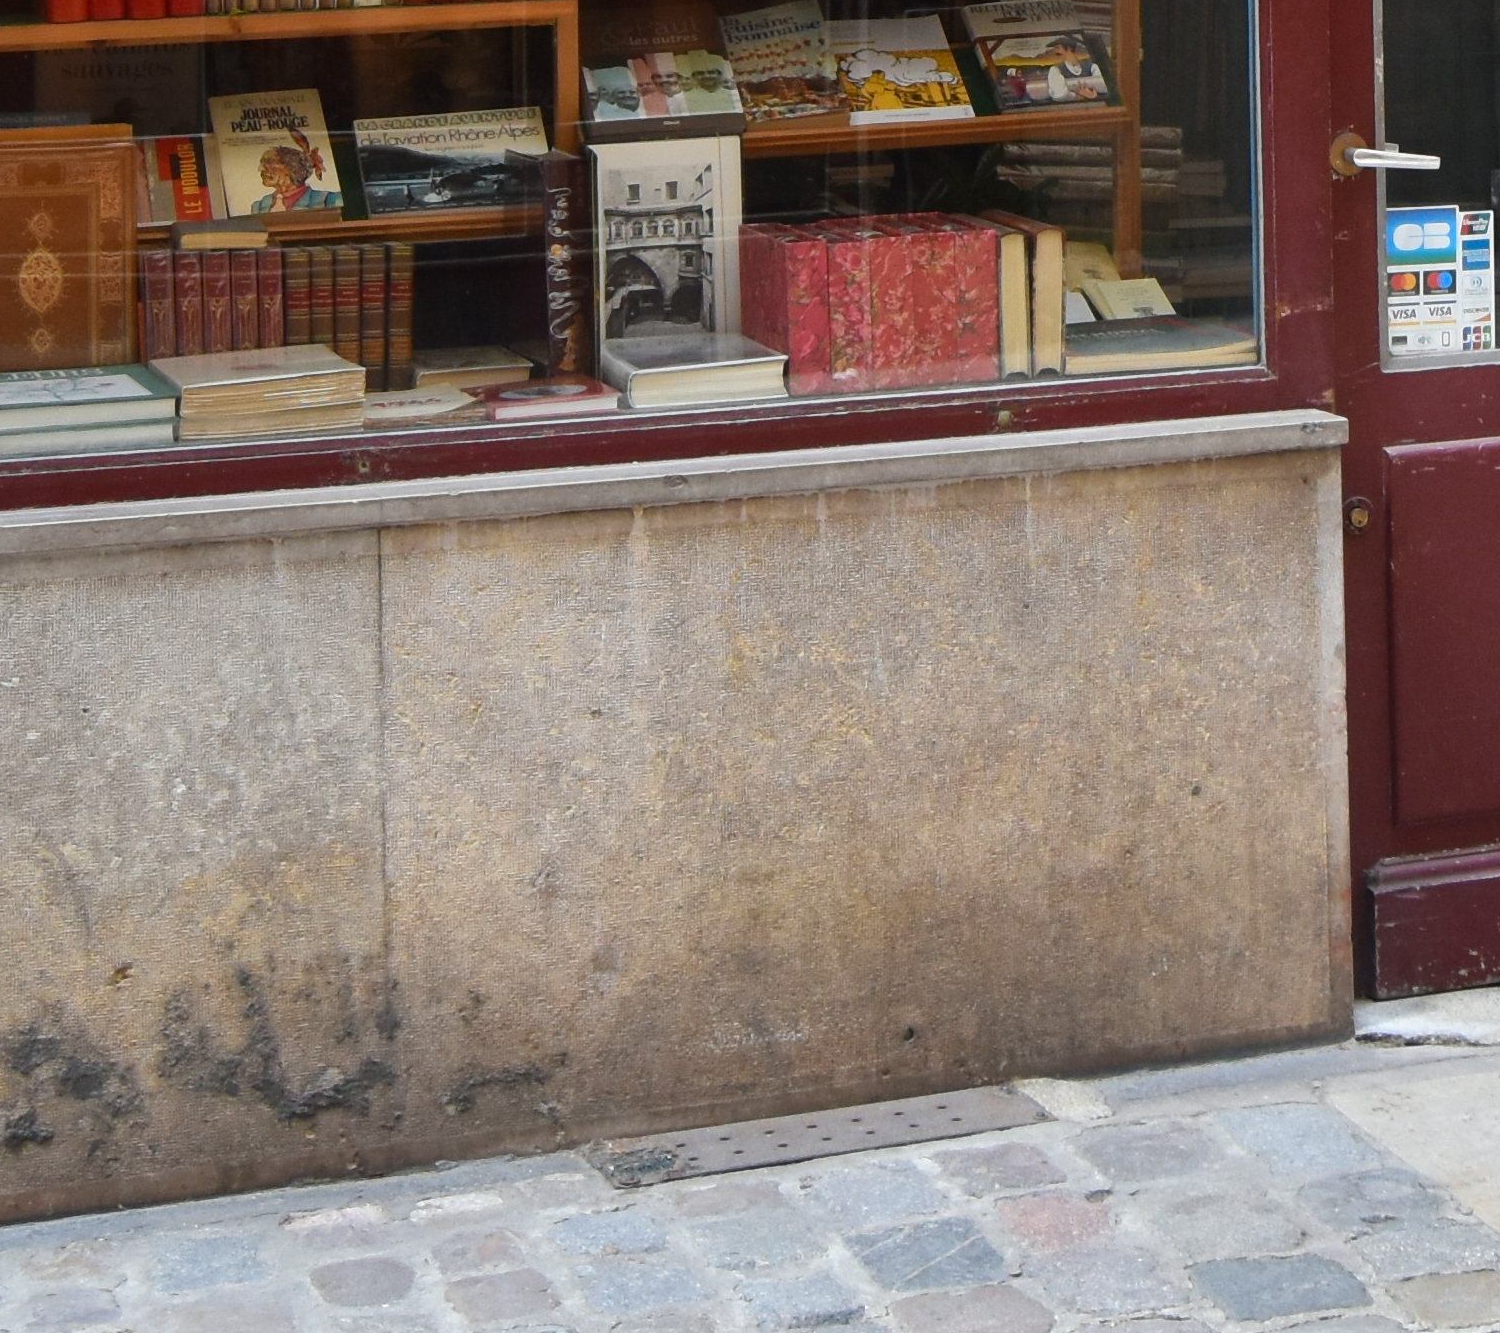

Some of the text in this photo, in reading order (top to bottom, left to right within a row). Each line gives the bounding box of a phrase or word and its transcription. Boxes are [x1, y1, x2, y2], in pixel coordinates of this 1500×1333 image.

[724, 15, 795, 35] cuisine
[724, 19, 822, 44] lyonnaise
[628, 34, 698, 46] les autres
[240, 104, 296, 121] JOURNAL
[357, 107, 538, 131] LA GRANDE AVENTURE
[230, 115, 309, 133] PEAU-ROUGE
[360, 132, 382, 147] de
[448, 124, 497, 144] Rhône
[498, 123, 541, 143] Alpes
[176, 142, 203, 214] LE MODULOR
[1392, 221, 1451, 252] CB
[1392, 306, 1453, 320] VISA VISA
